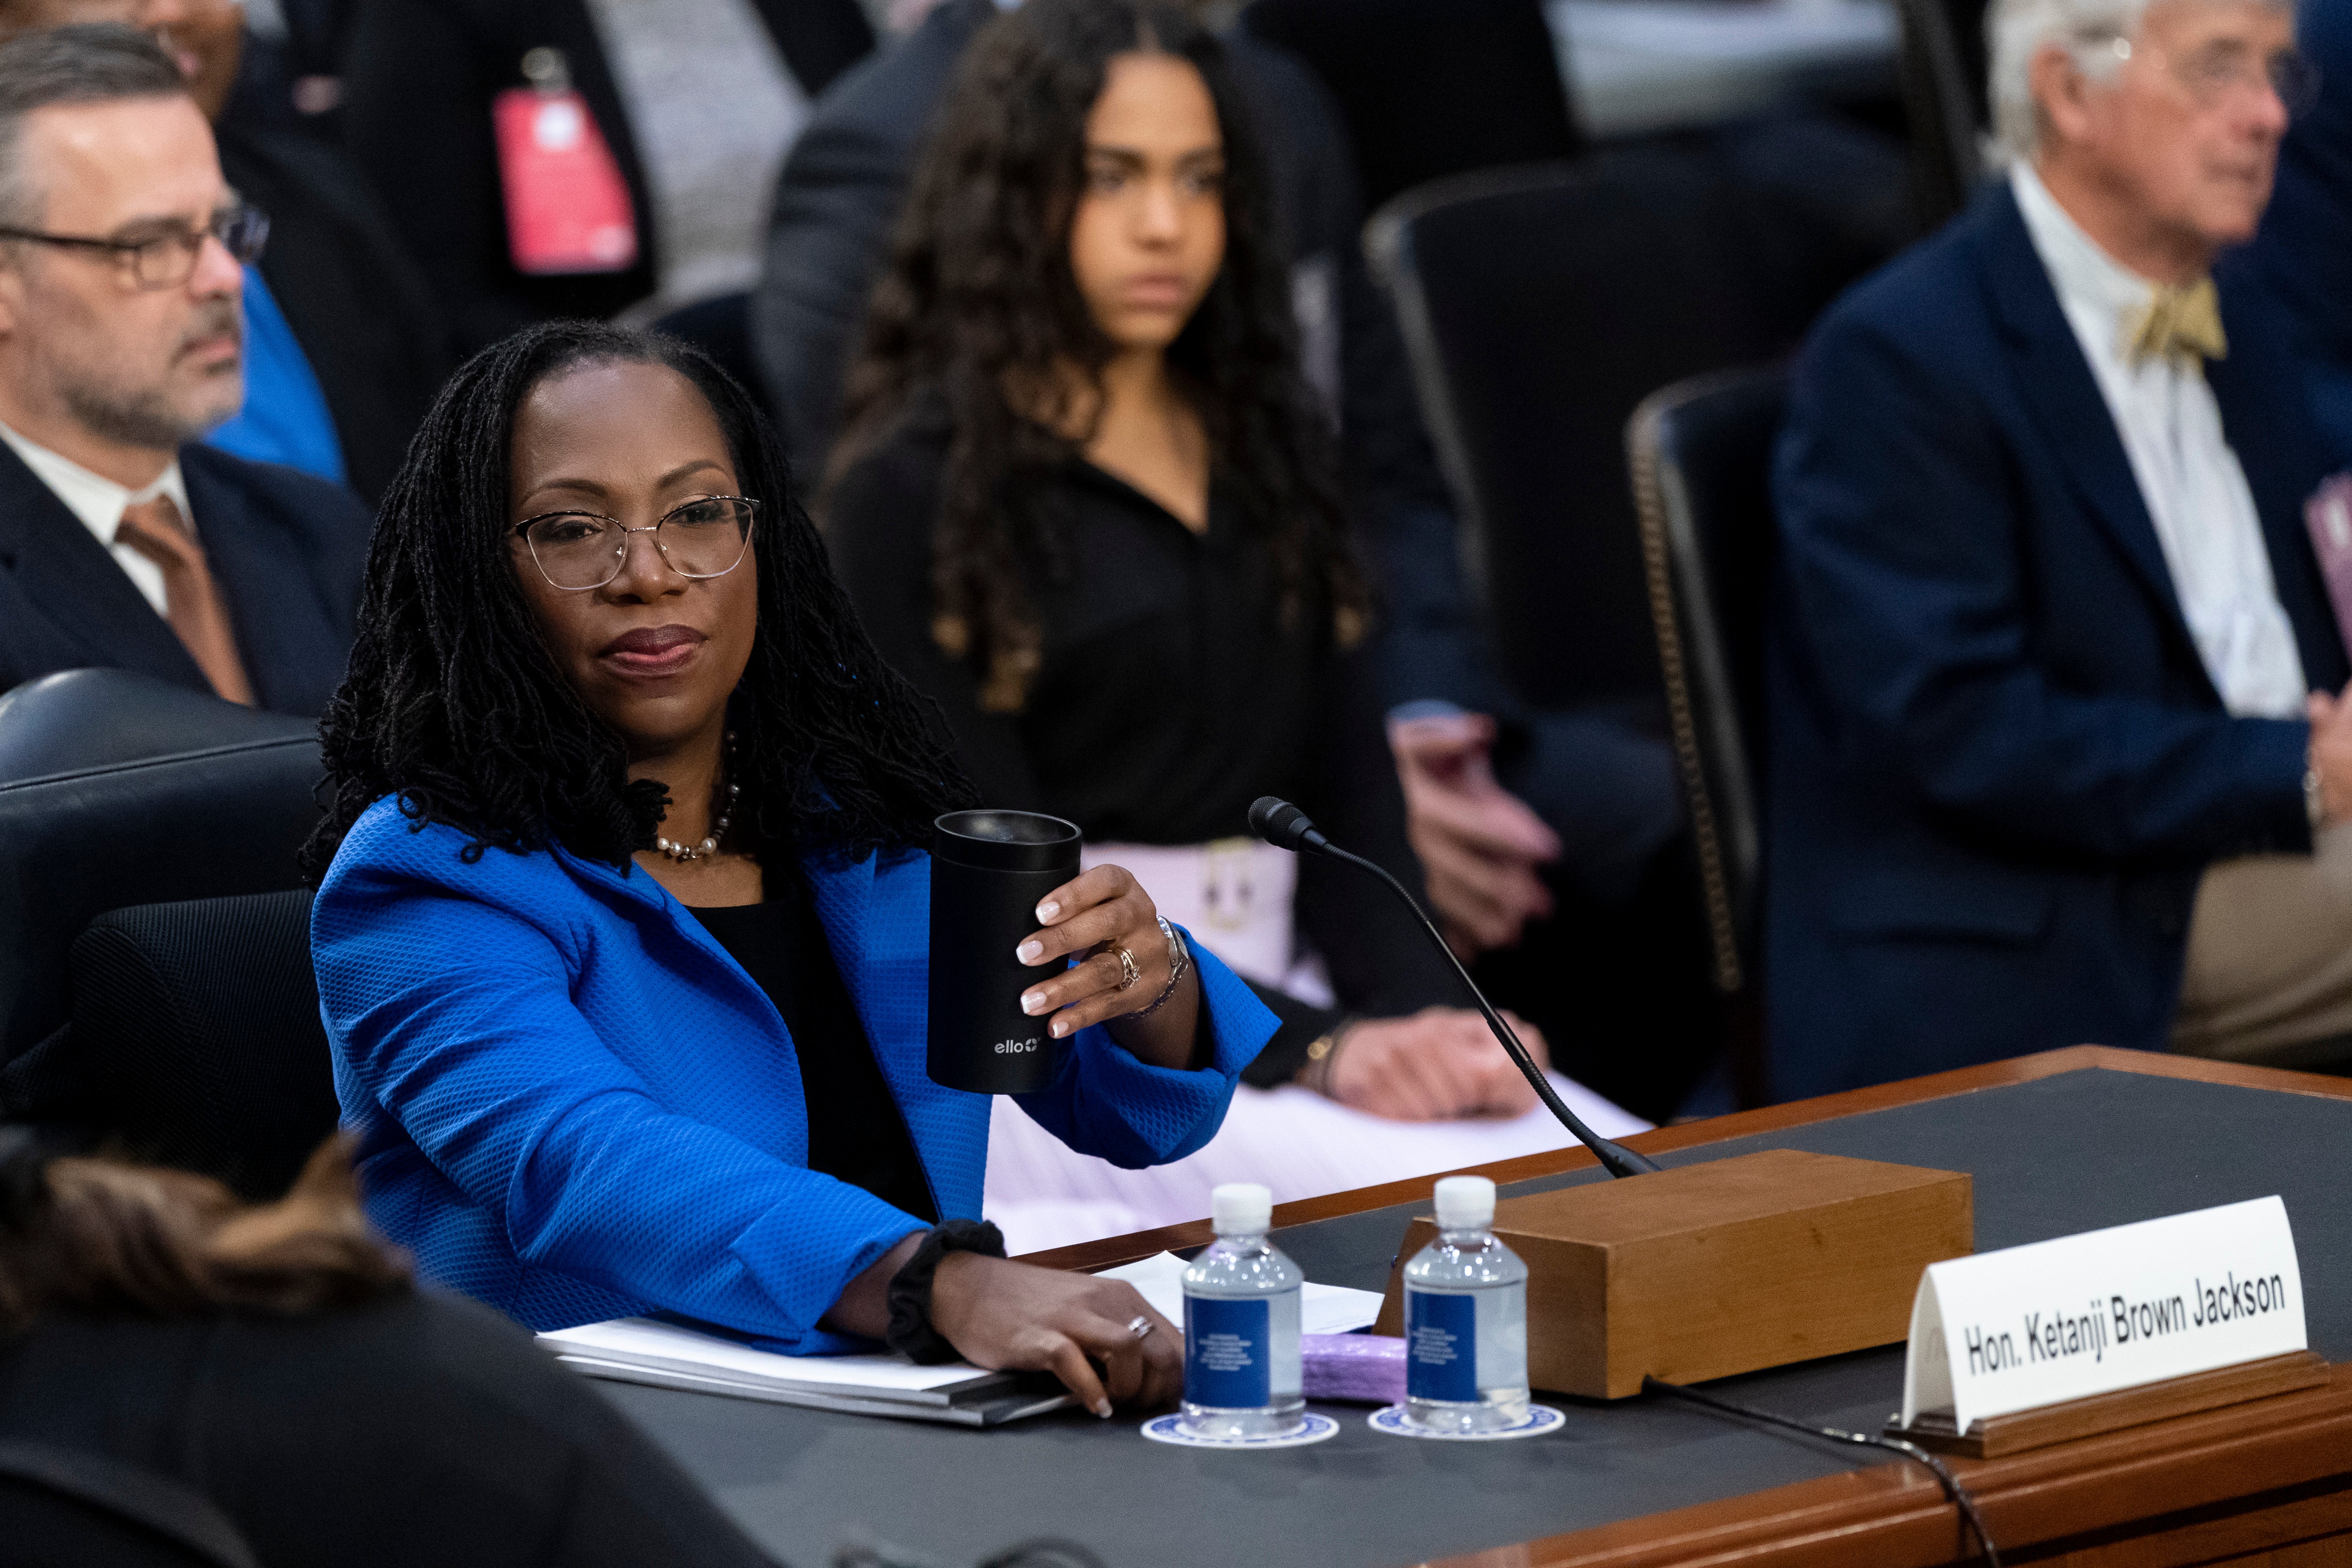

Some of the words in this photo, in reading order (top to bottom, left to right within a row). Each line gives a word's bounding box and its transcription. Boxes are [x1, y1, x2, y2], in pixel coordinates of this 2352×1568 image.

[995, 1040, 1023, 1053] ello
[1966, 1326, 2022, 1375] Hon.
[2025, 1300, 2108, 1363] Ketanji
[2111, 1295, 2186, 1344] Brown
[2193, 1272, 2285, 1327] Jackson
